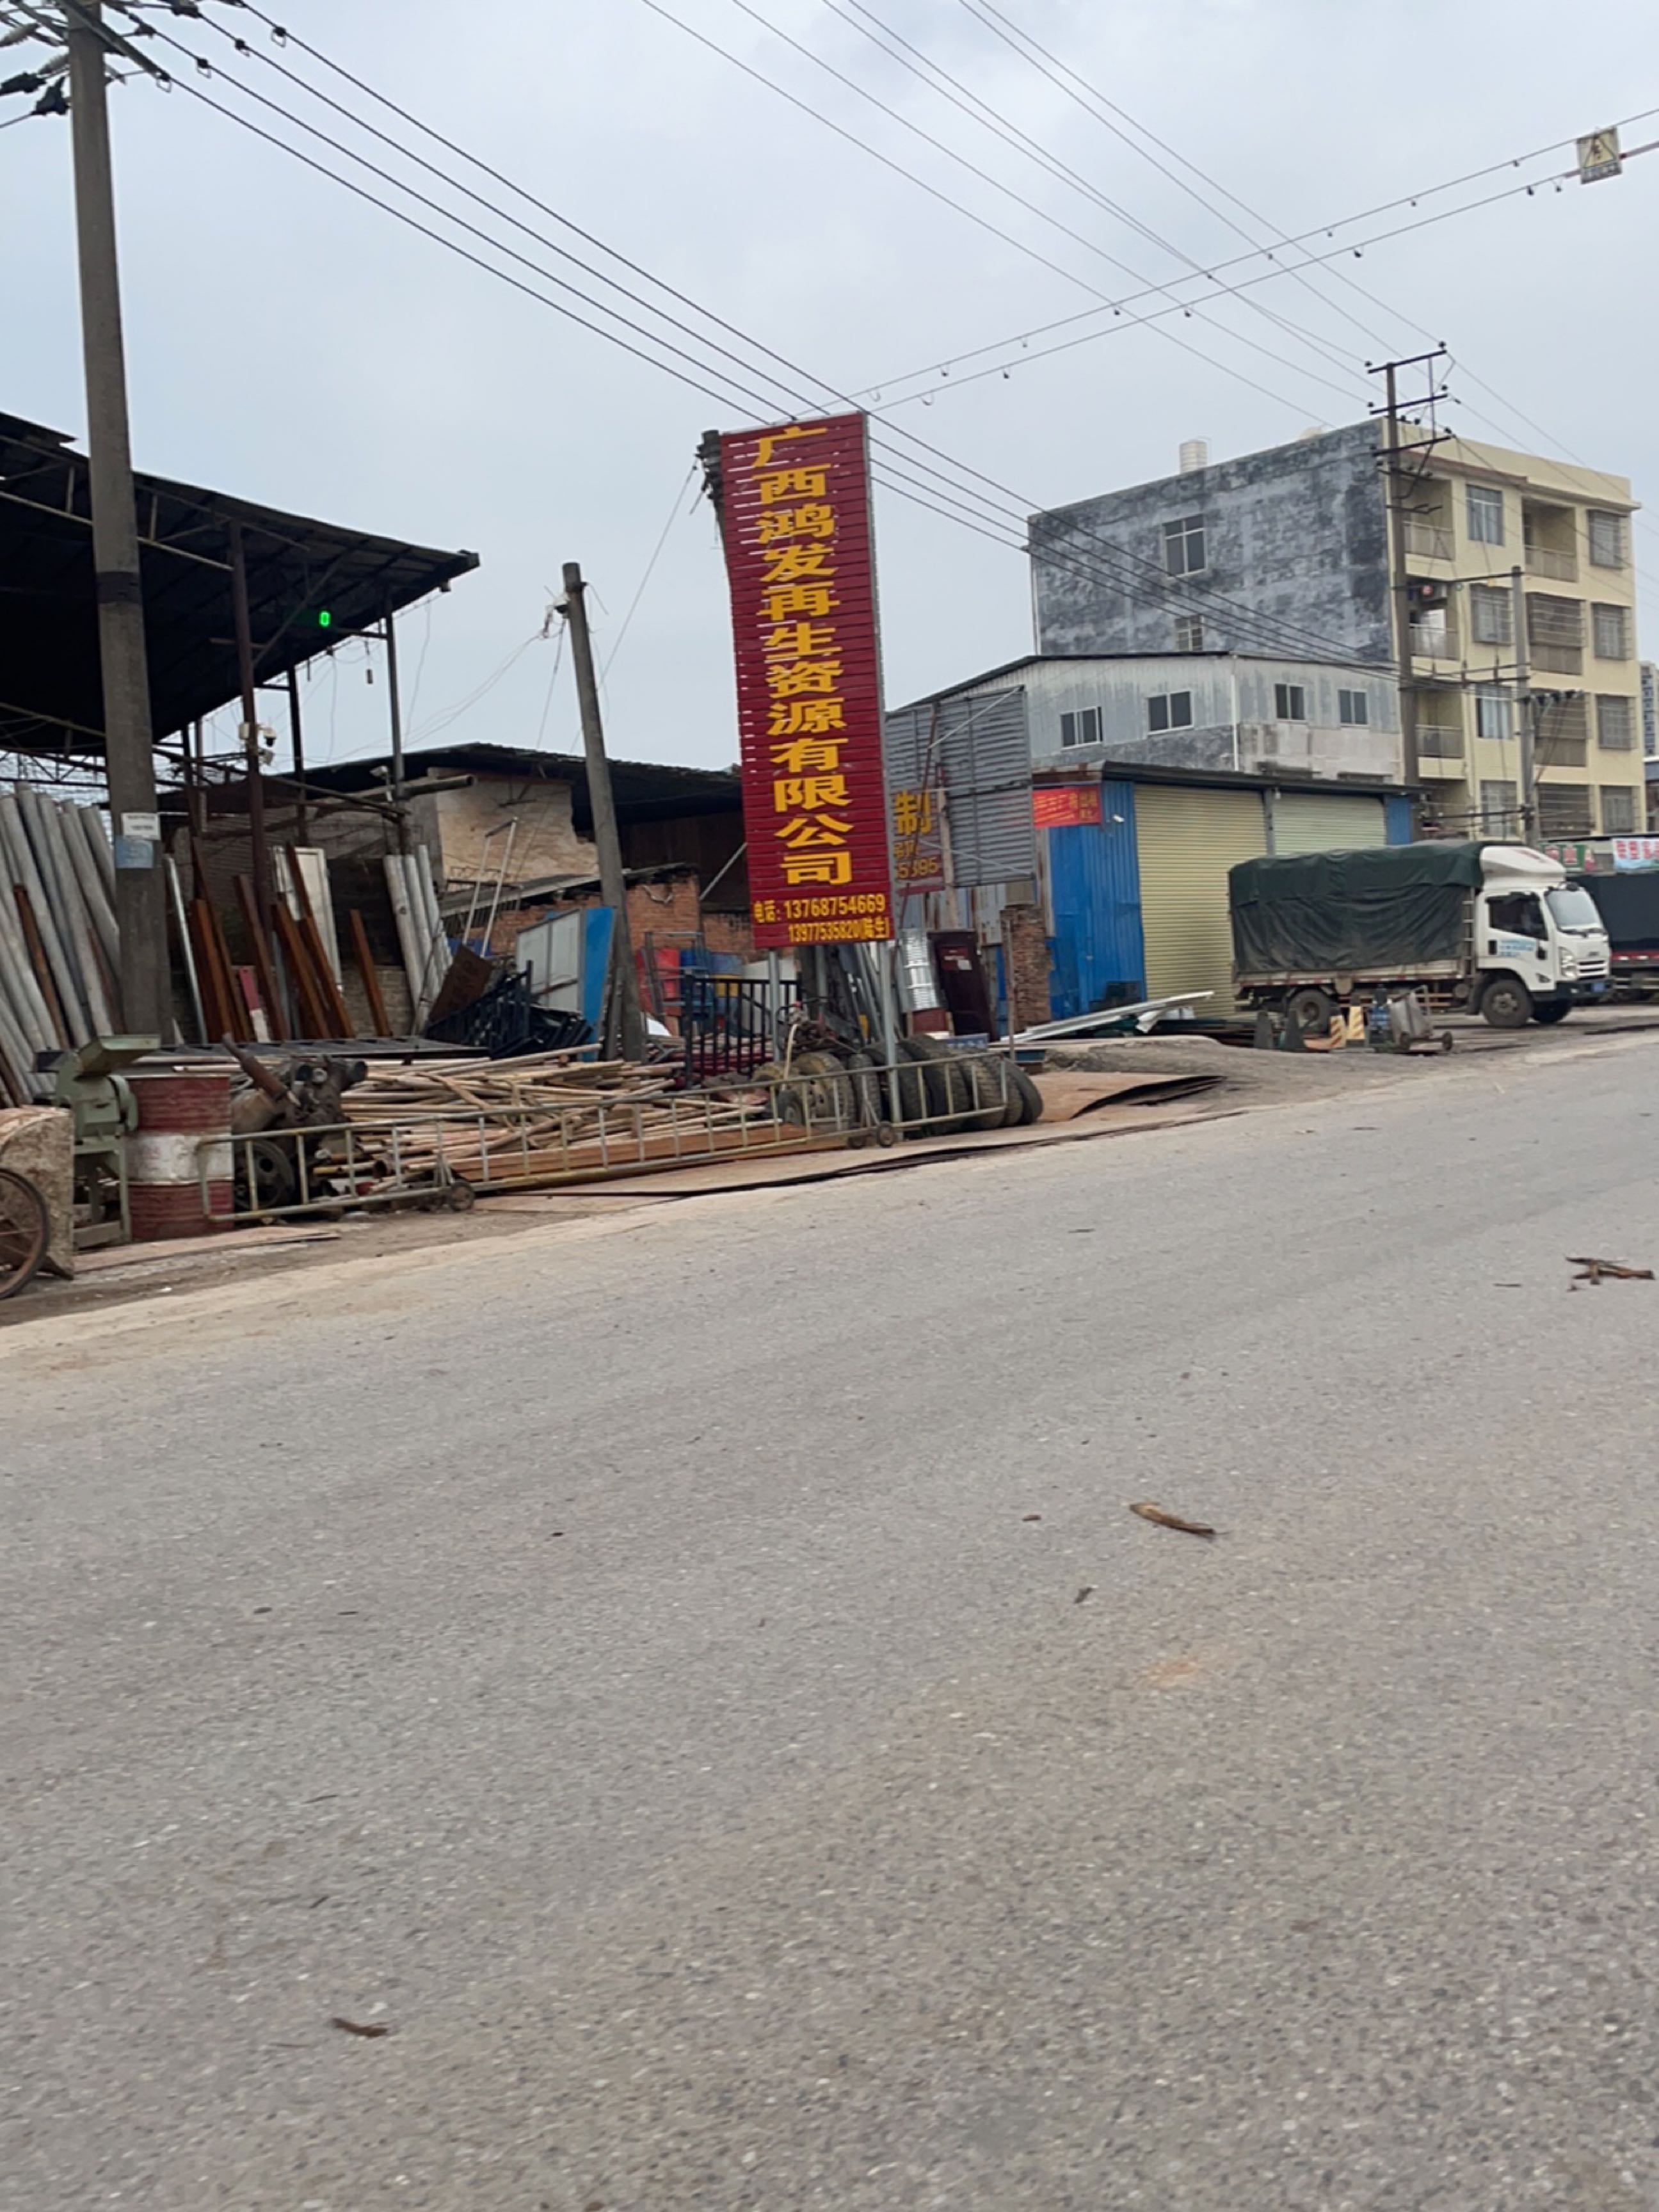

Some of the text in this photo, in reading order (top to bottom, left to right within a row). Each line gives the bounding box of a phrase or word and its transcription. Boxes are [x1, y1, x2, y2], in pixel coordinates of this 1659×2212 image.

[752, 426, 854, 885] 广西鸿发再生资源有限公司
